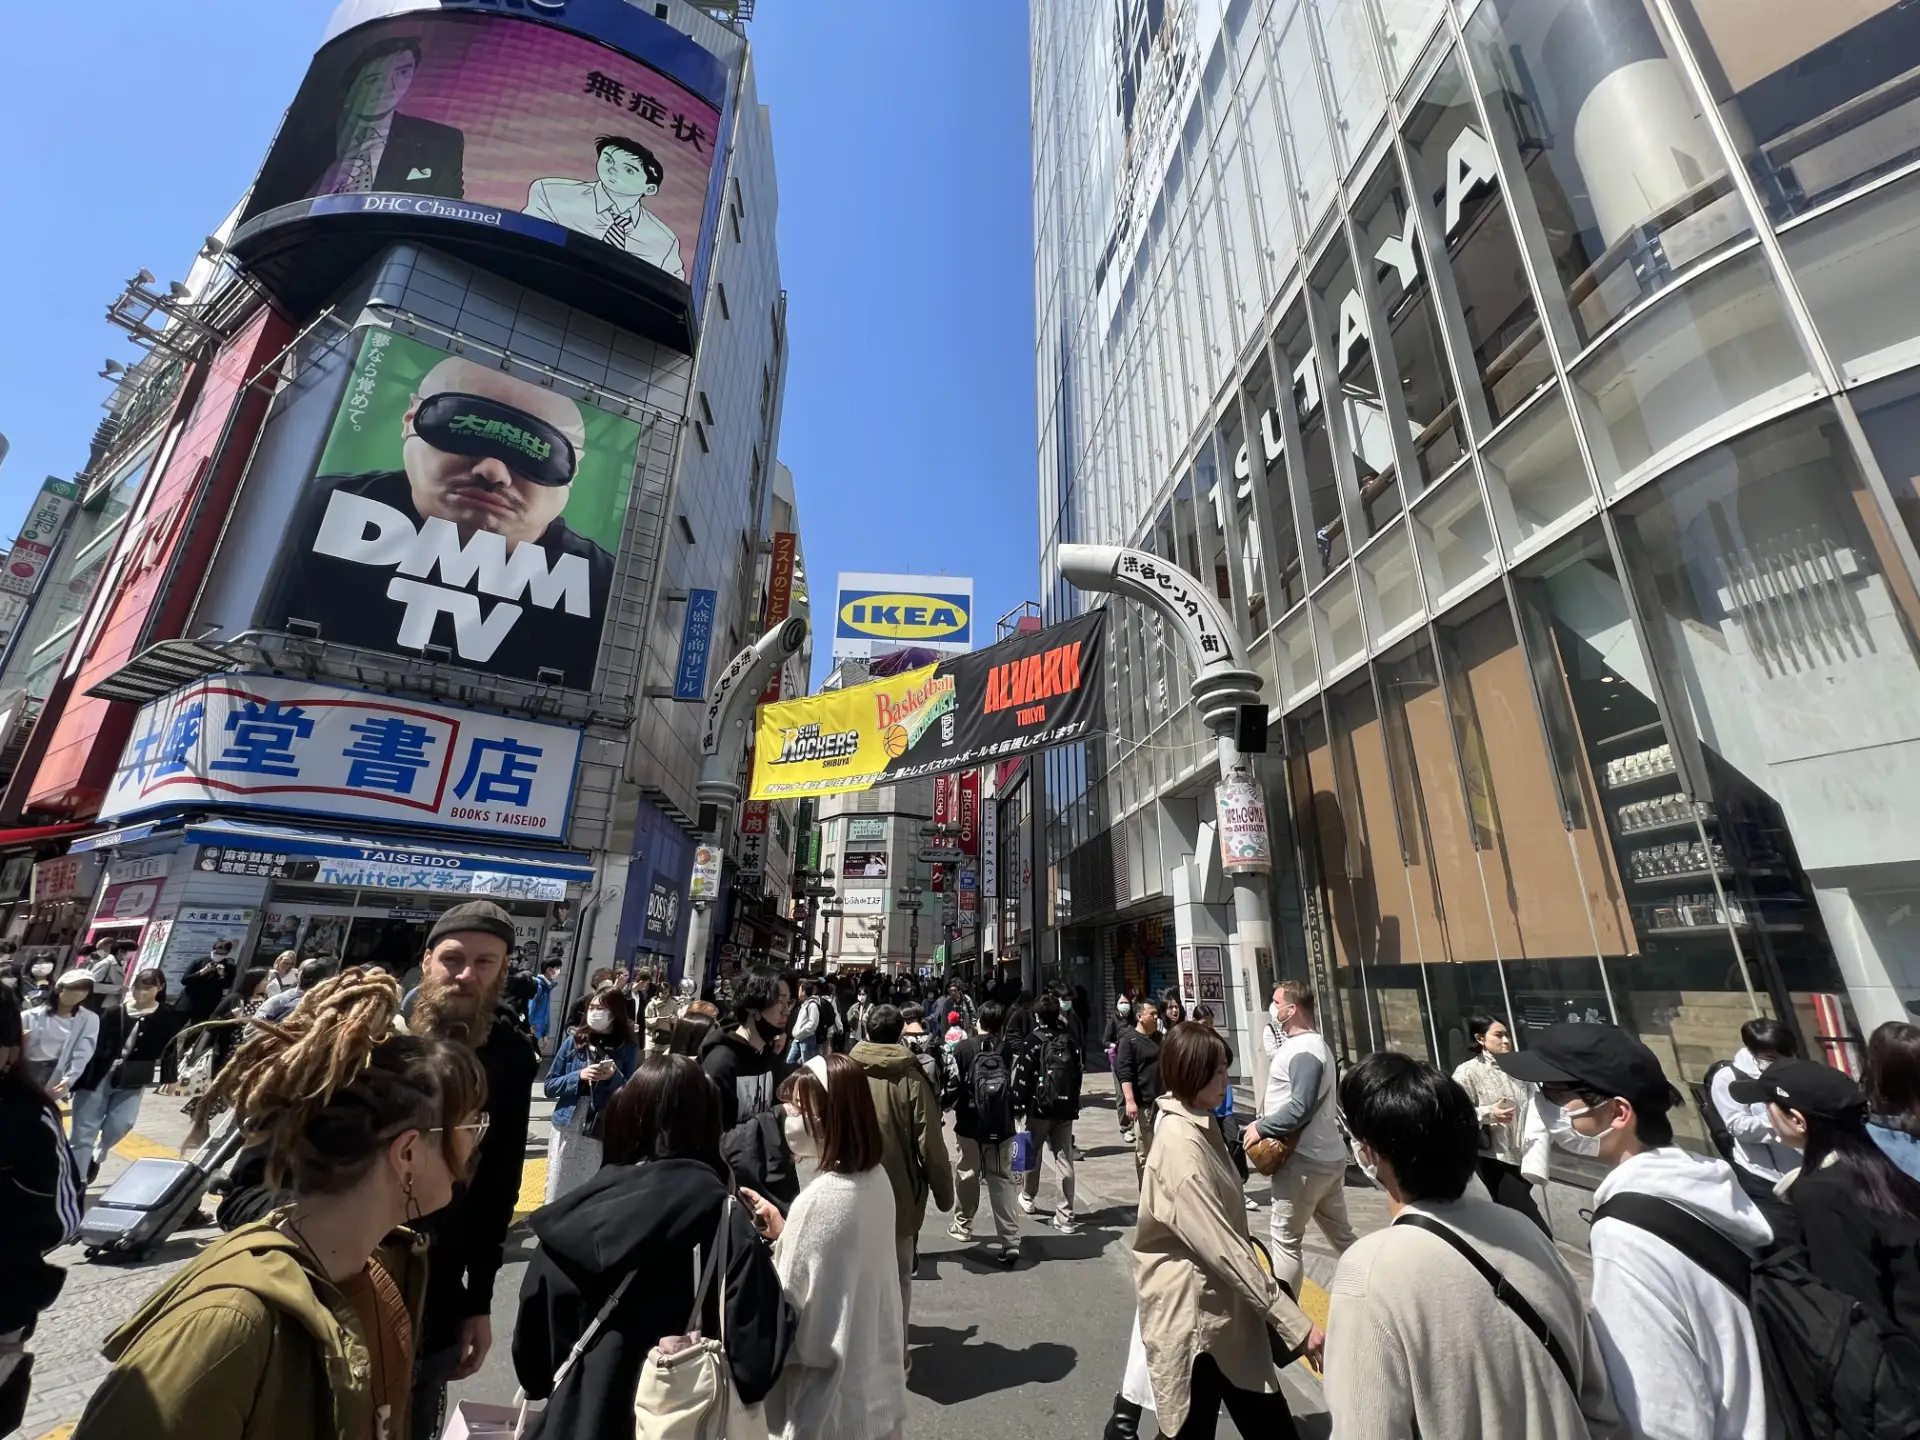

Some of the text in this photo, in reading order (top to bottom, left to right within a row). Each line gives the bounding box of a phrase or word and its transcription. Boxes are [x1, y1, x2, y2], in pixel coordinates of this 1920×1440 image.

[583, 70, 705, 152] 無症状
[363, 196, 501, 226] DHC Channel
[1209, 125, 1497, 529] TSUTAYA
[349, 333, 389, 432] 夢なら覚めて。
[448, 414, 552, 458] 大脱出
[312, 489, 591, 619] DMM
[386, 576, 523, 663] TV
[852, 604, 958, 628] IKEA
[1123, 556, 1220, 653] 渋谷センター街
[679, 595, 712, 696] 大盛堂商事ビル
[984, 641, 1082, 716] ALVARK
[702, 651, 753, 750] 渋谷センター街
[876, 676, 954, 730] Basketball
[1016, 705, 1046, 727] TOKYO
[768, 727, 860, 765] ROCKERS
[798, 723, 821, 738] SUN
[117, 702, 543, 807] 大盛堂書店
[822, 757, 850, 769] SHIBUYA
[451, 806, 547, 828] BOOKS TAISEIDO
[961, 789, 972, 841] BIG ECHO
[1225, 807, 1264, 824] WELCOME
[220, 862, 283, 878] 窓際三等兵
[224, 849, 288, 865] 麻布競馬場
[360, 849, 461, 868] TAISEIDO
[321, 867, 558, 892] Twitter文学アンソロジー
[187, 911, 243, 921] 大盛堂書店
[647, 892, 668, 920] BOSS
[1312, 930, 1327, 993] COFFEE
